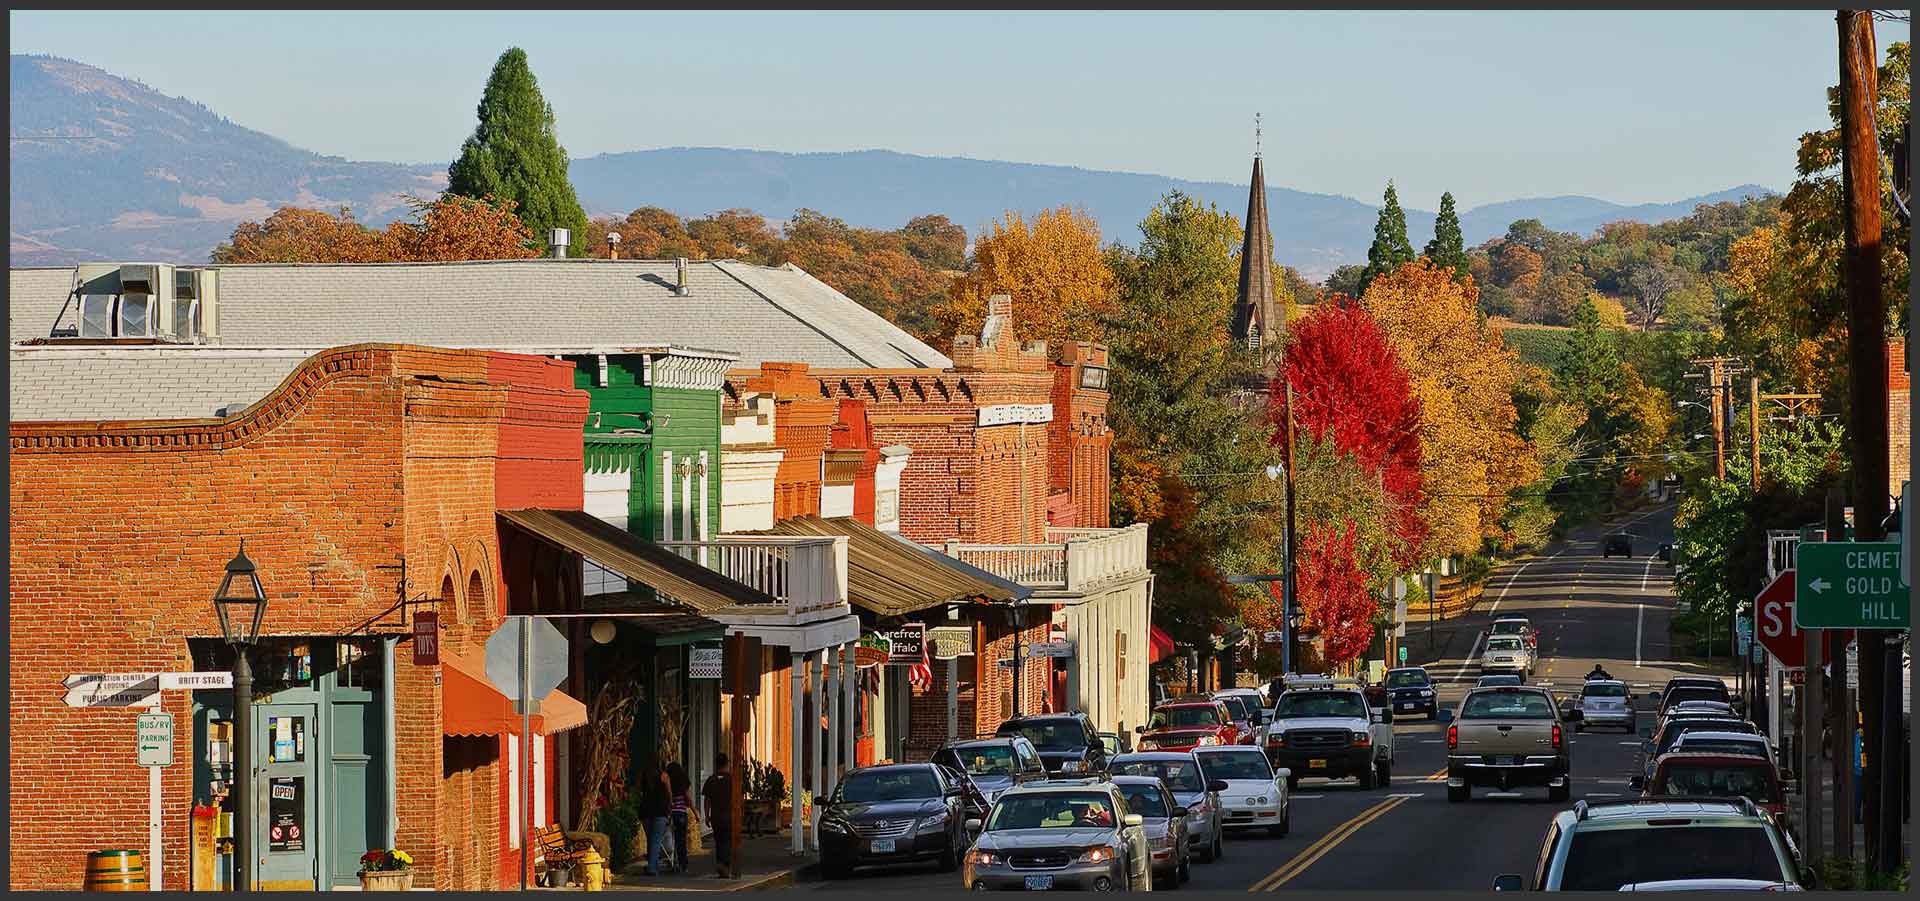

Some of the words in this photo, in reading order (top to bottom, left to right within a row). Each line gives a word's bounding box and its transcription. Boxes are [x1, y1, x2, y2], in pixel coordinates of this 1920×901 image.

[1846, 552, 1900, 569] CEMET
[1846, 577, 1892, 594] GOLD
[1862, 602, 1900, 620] HILL
[1763, 602, 1798, 637] ST
[884, 628, 921, 639] arefree
[416, 635, 435, 655] TOYS
[80, 674, 121, 683] INFORMATION
[178, 676, 200, 685] BRITT
[202, 676, 225, 685] STAGE
[82, 694, 108, 702] PUBLIC
[110, 694, 143, 702] PARKING
[139, 721, 169, 729] BUS/RV
[274, 785, 295, 798] OPEN
